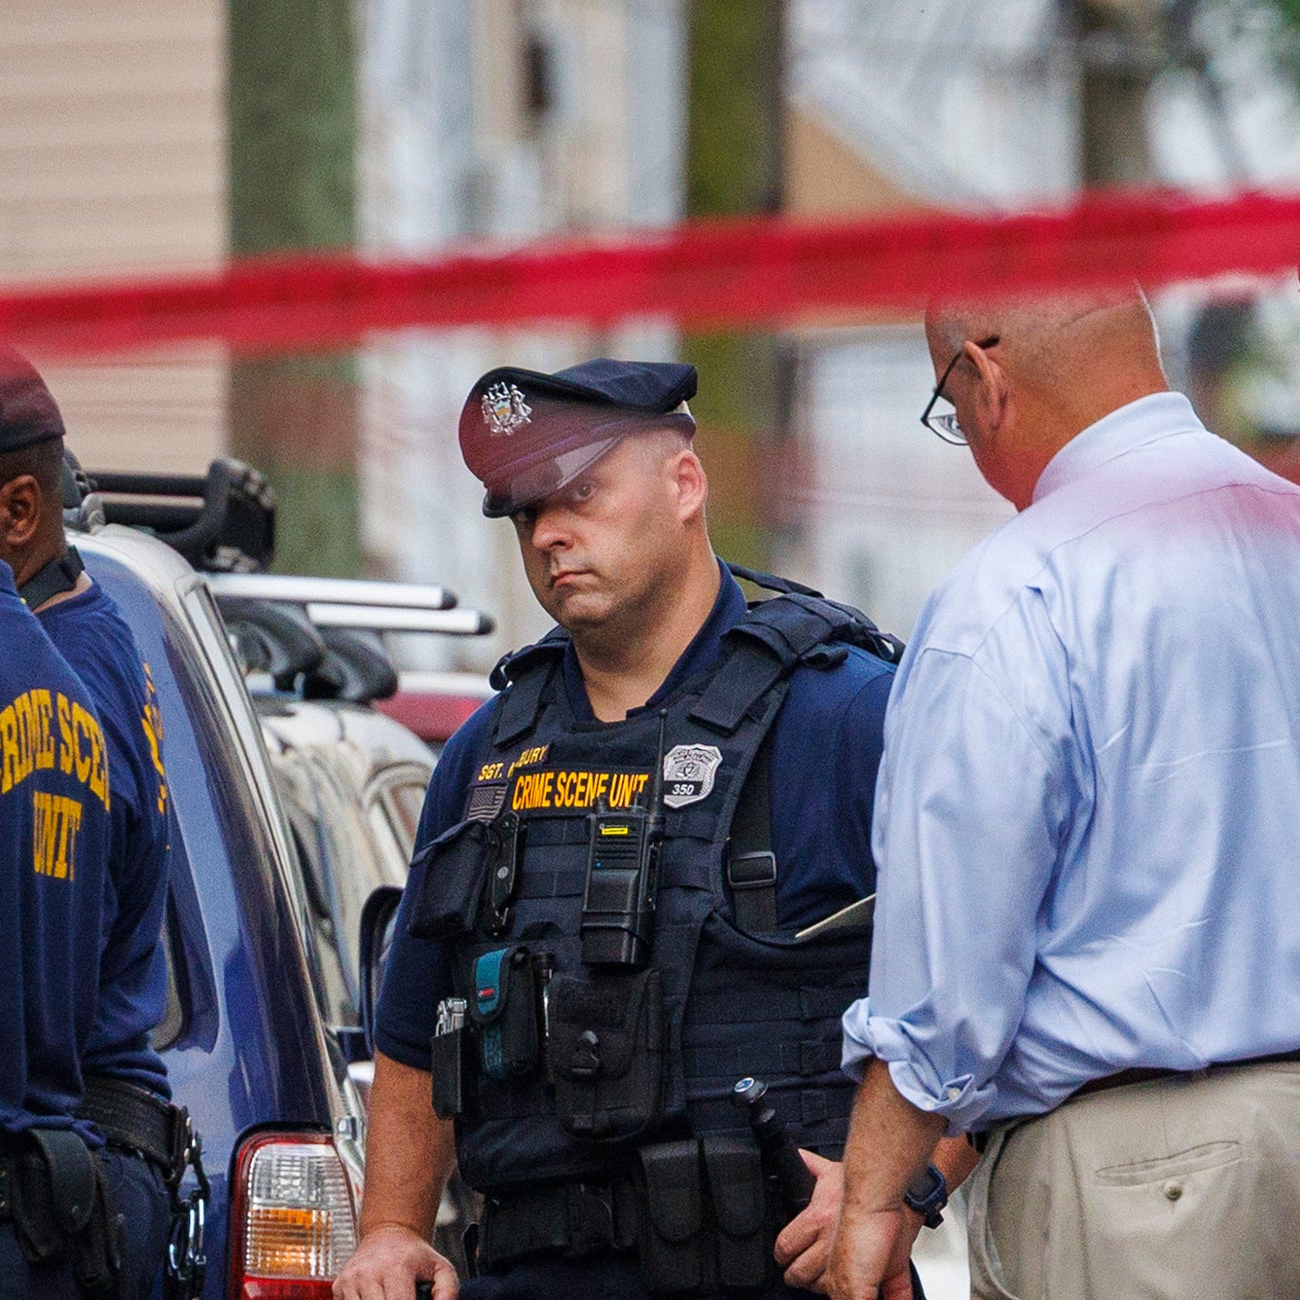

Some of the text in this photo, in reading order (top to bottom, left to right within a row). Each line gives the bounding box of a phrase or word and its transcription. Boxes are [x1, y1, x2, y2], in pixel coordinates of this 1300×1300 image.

[57, 692, 110, 812] SCE
[478, 763, 504, 781] SGT.
[512, 773, 554, 810] CRIME
[671, 784, 695, 795] 350
